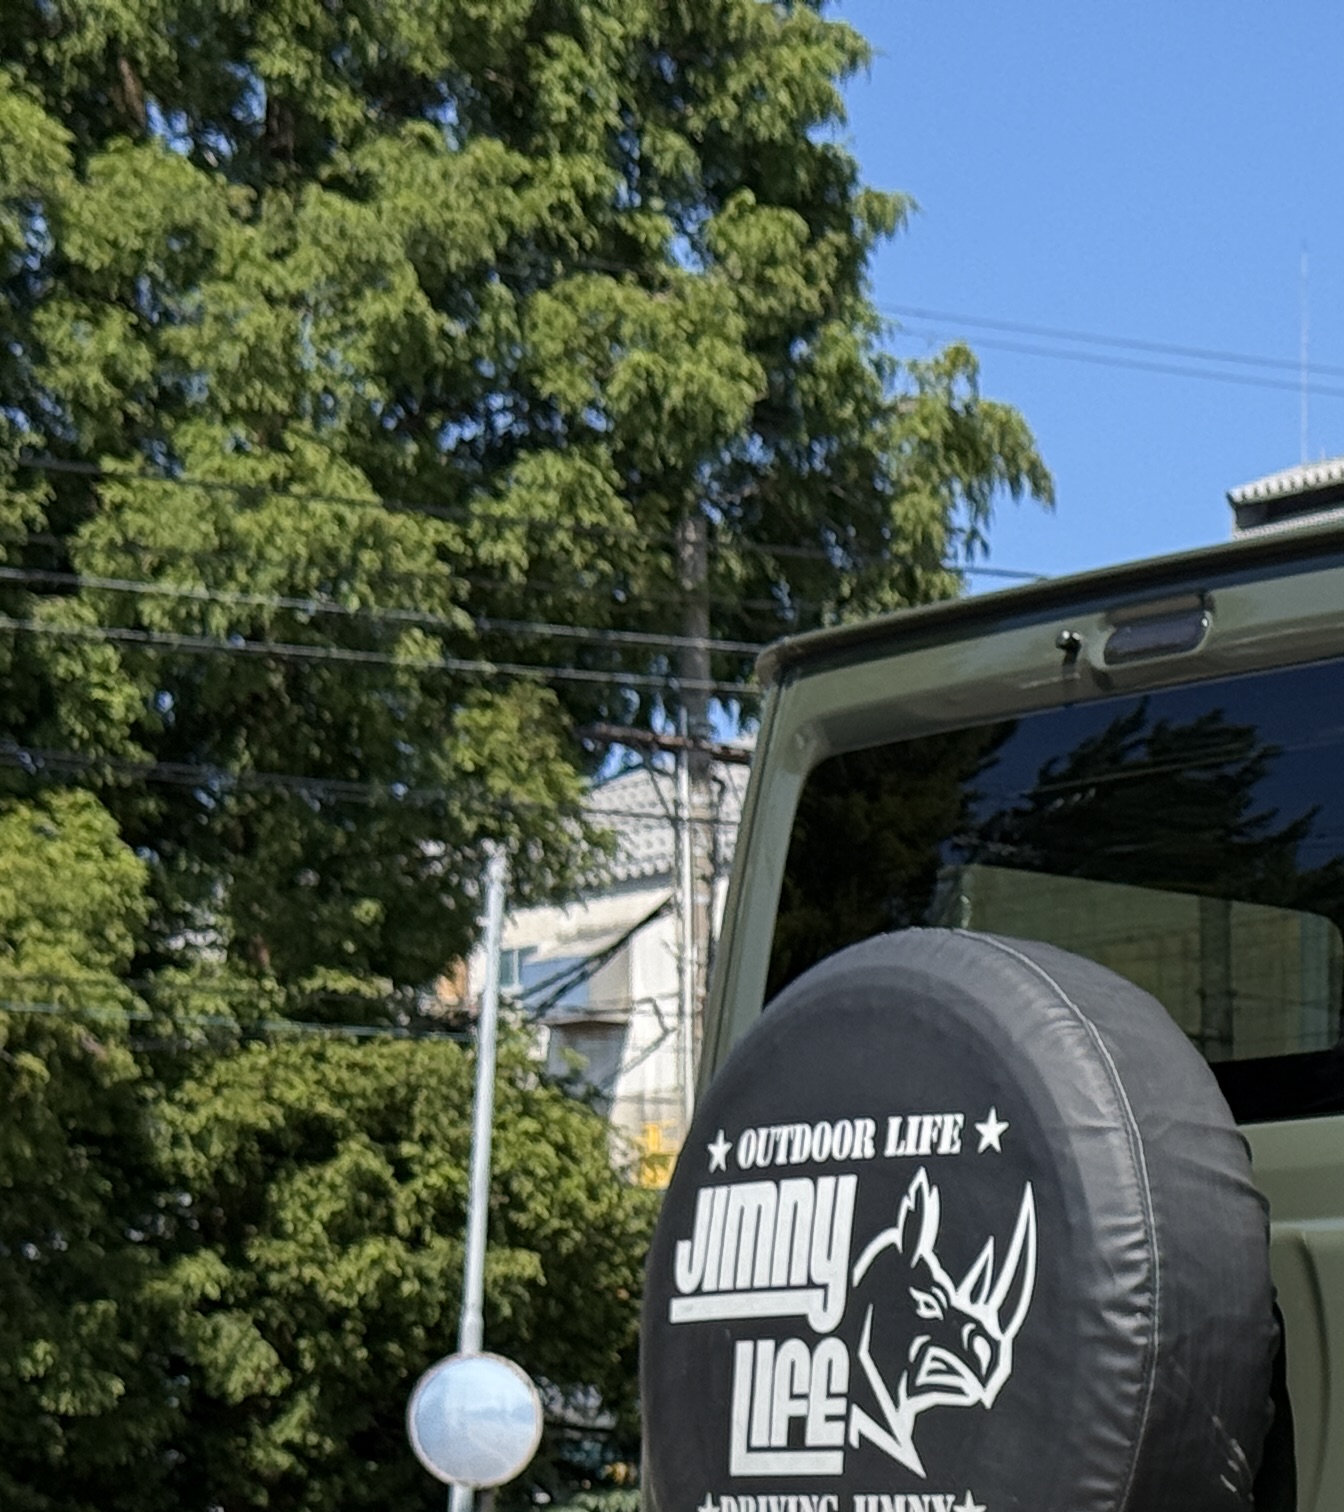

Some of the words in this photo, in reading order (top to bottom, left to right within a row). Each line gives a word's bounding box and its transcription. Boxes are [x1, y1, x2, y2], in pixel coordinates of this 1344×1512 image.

[736, 1117, 876, 1170] OUTDOOR
[884, 1113, 964, 1159] LIFE
[730, 1336, 849, 1476] LIFE
